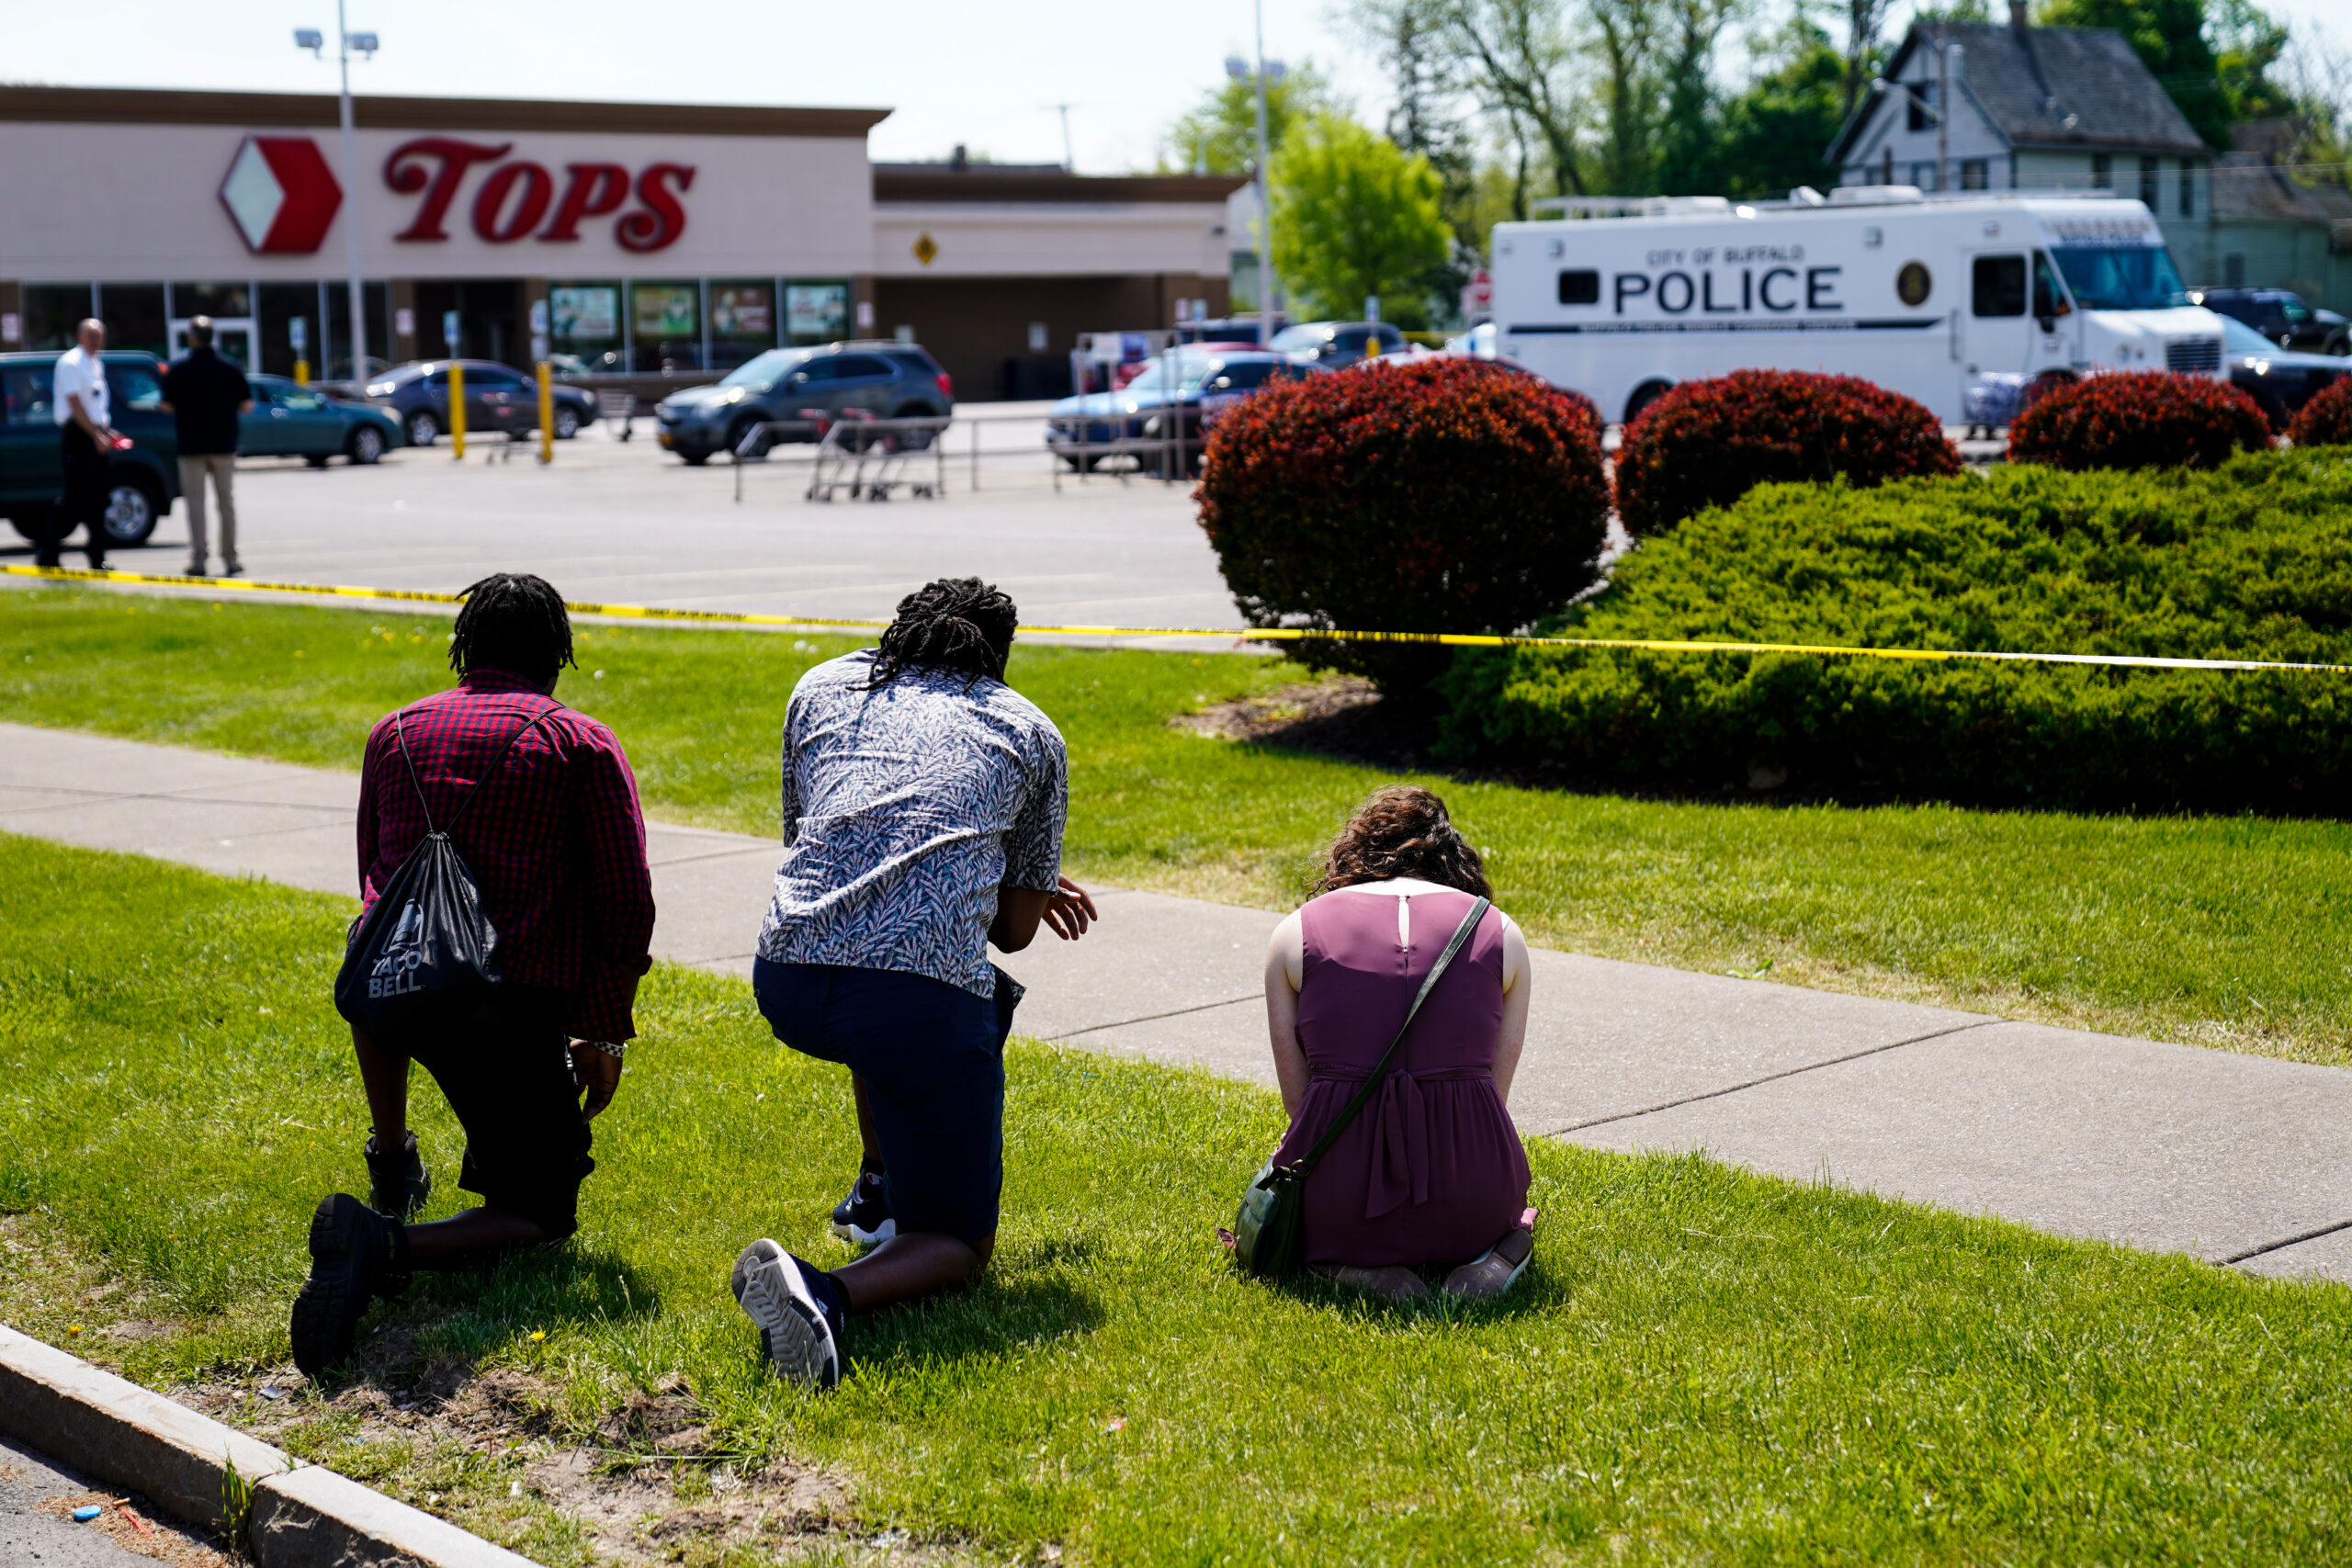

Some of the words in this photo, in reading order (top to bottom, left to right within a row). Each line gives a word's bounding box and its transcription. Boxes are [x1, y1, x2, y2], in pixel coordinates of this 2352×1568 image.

[382, 135, 696, 254] TOPS
[1646, 248, 1685, 266] CITY
[1694, 247, 1716, 265] OF
[1724, 243, 1804, 264] BUFFALO
[1613, 265, 1843, 314] POLICE
[371, 950, 422, 976] TACO
[368, 971, 422, 998] BELL
